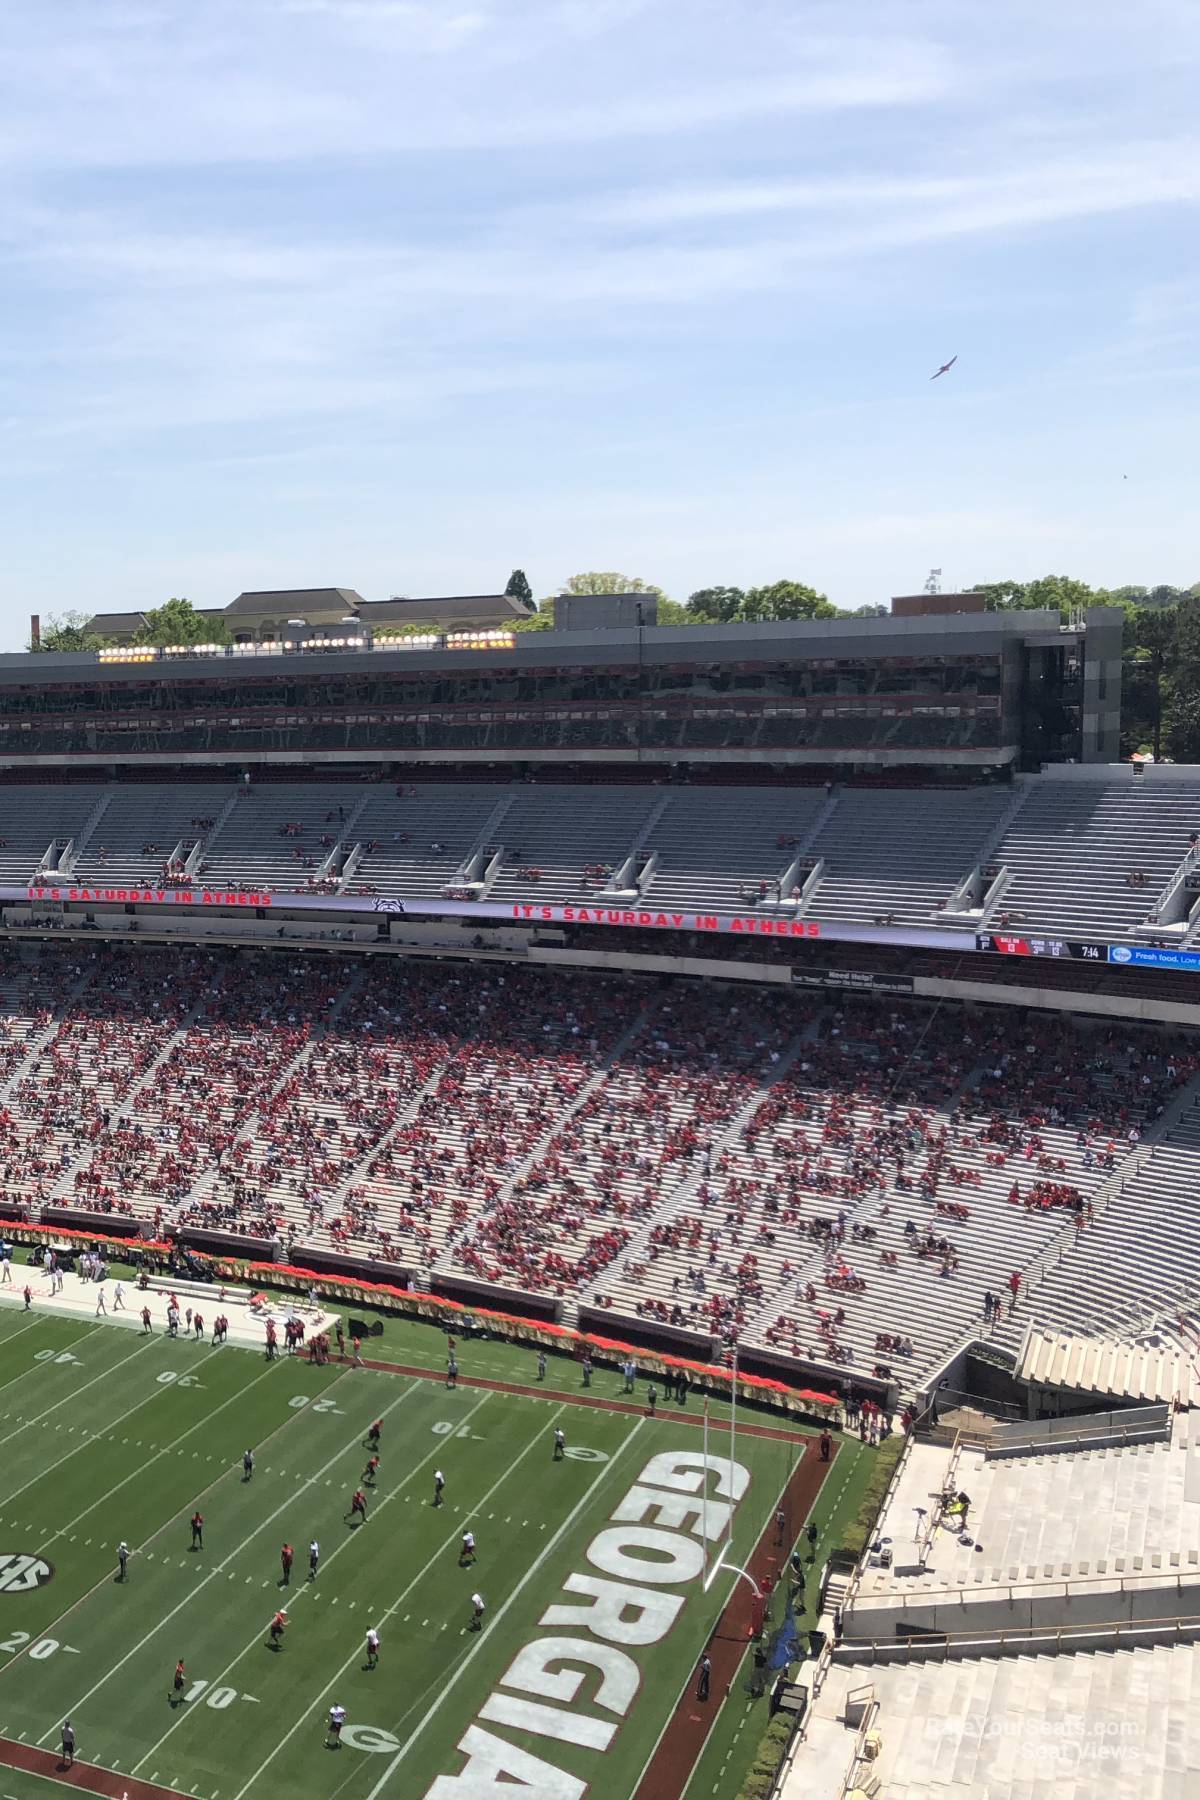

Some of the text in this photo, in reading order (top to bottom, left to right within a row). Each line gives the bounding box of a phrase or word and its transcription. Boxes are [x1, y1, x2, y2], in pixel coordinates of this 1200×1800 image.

[28, 888, 272, 905] IT'S SATURDAY IN ATHENS
[513, 905, 820, 936] IT'S SATURDAY IN ATHENS
[1082, 947, 1099, 958] 7:14
[1136, 952, 1157, 960] Fresh
[1159, 954, 1179, 962] food.
[33, 1349, 76, 1364] 40
[156, 1370, 200, 1387] 30
[288, 1395, 338, 1415] 20
[432, 1420, 477, 1438] 10
[421, 1450, 751, 1800] GEORGIA
[182, 1680, 238, 1709] 10
